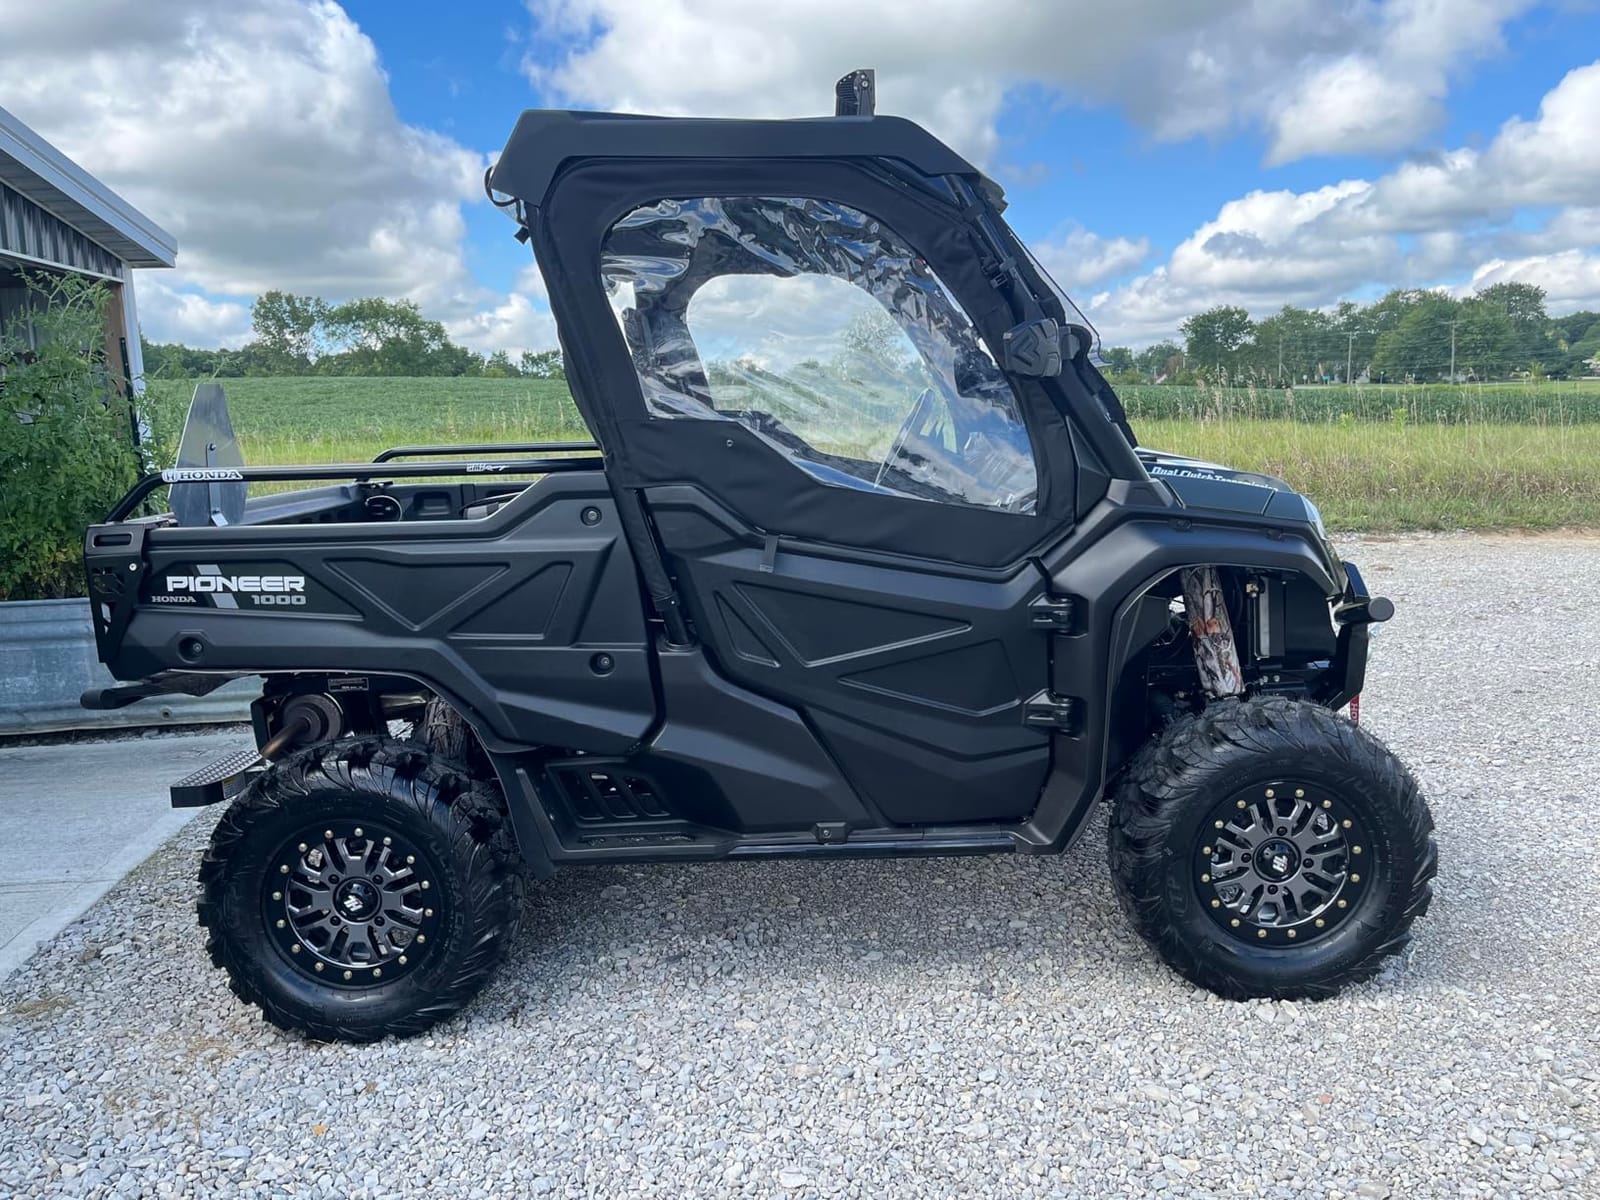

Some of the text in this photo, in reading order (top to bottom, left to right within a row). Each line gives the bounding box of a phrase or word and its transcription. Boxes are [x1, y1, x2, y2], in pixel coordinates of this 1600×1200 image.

[179, 470, 242, 480] HONDA
[1151, 466, 1178, 476] Dual
[1179, 470, 1213, 480] Clutch
[166, 576, 305, 592] PIONEER
[151, 595, 197, 603] HONDA
[251, 594, 307, 605] 1000
